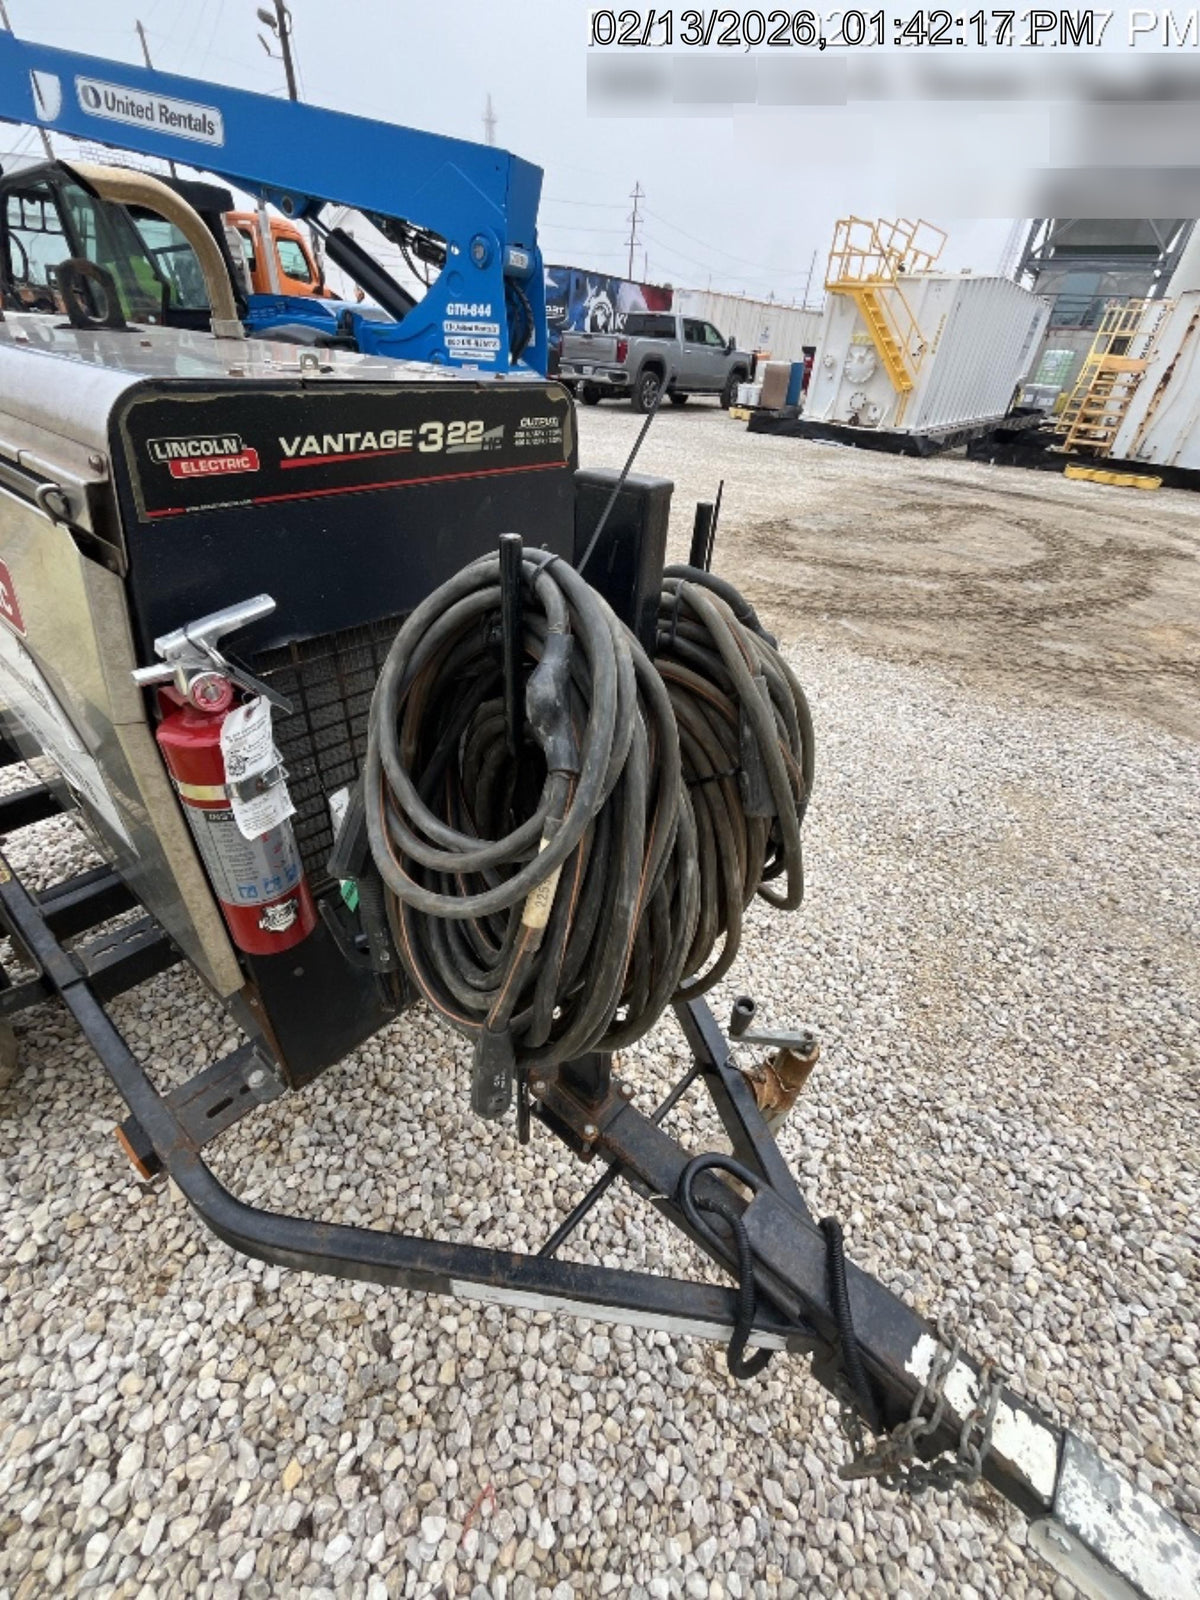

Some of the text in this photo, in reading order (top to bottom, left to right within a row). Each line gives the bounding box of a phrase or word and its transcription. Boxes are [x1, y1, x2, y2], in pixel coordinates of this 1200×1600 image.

[104, 90, 216, 136] United Rentals
[446, 303, 492, 317] GTH-844
[153, 438, 239, 460] LINCOLN
[278, 430, 414, 457] VANTAGE
[180, 457, 252, 474] ELECTRIC
